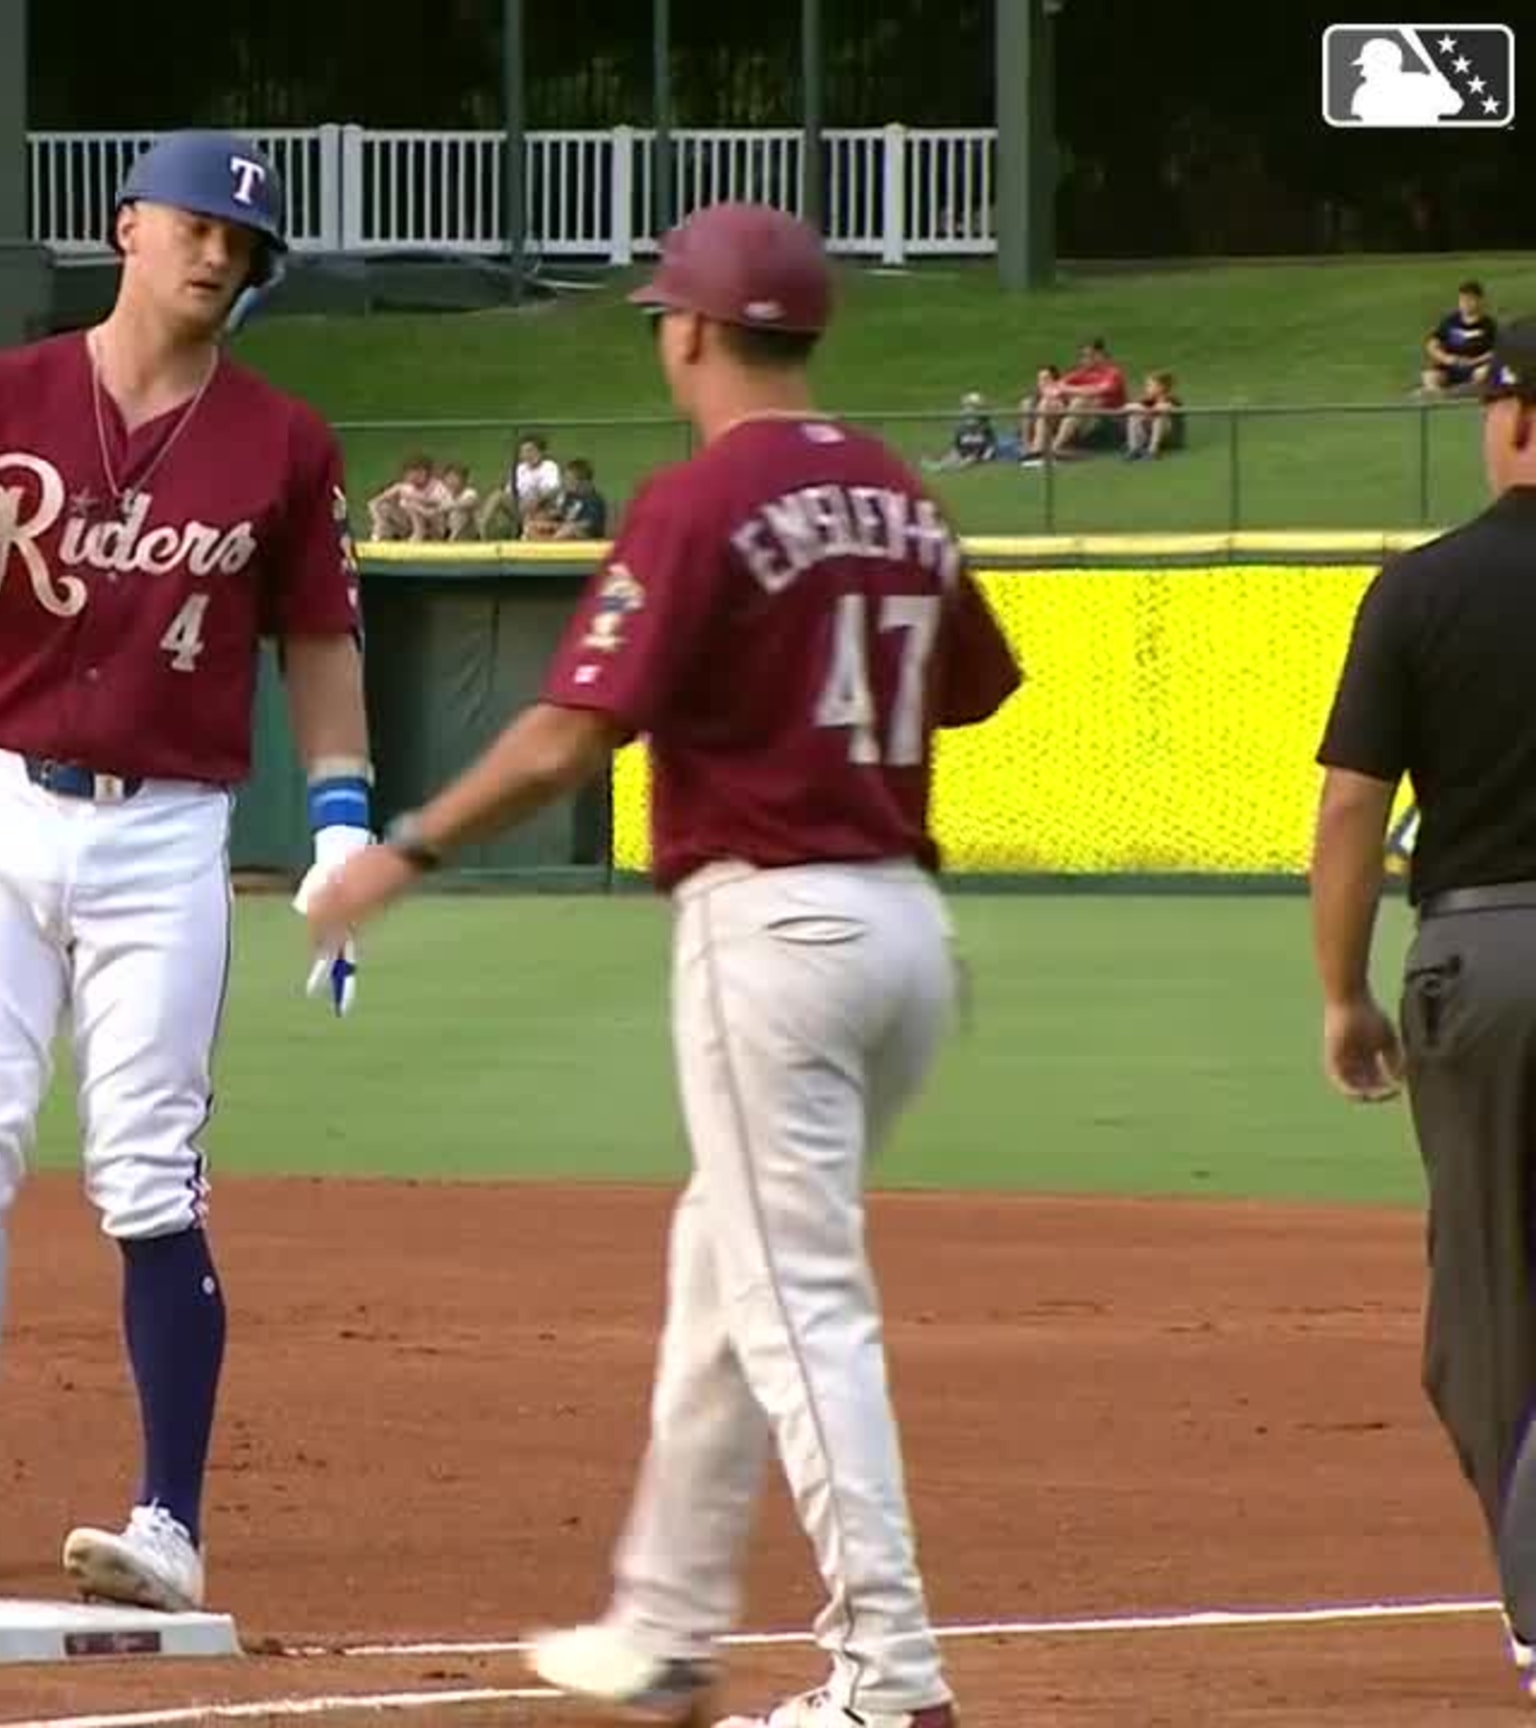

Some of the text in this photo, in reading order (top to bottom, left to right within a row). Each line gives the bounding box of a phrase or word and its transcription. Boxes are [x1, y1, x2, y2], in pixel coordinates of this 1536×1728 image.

[230, 157, 265, 204] T
[160, 594, 209, 672] 4
[816, 593, 941, 766] 47
